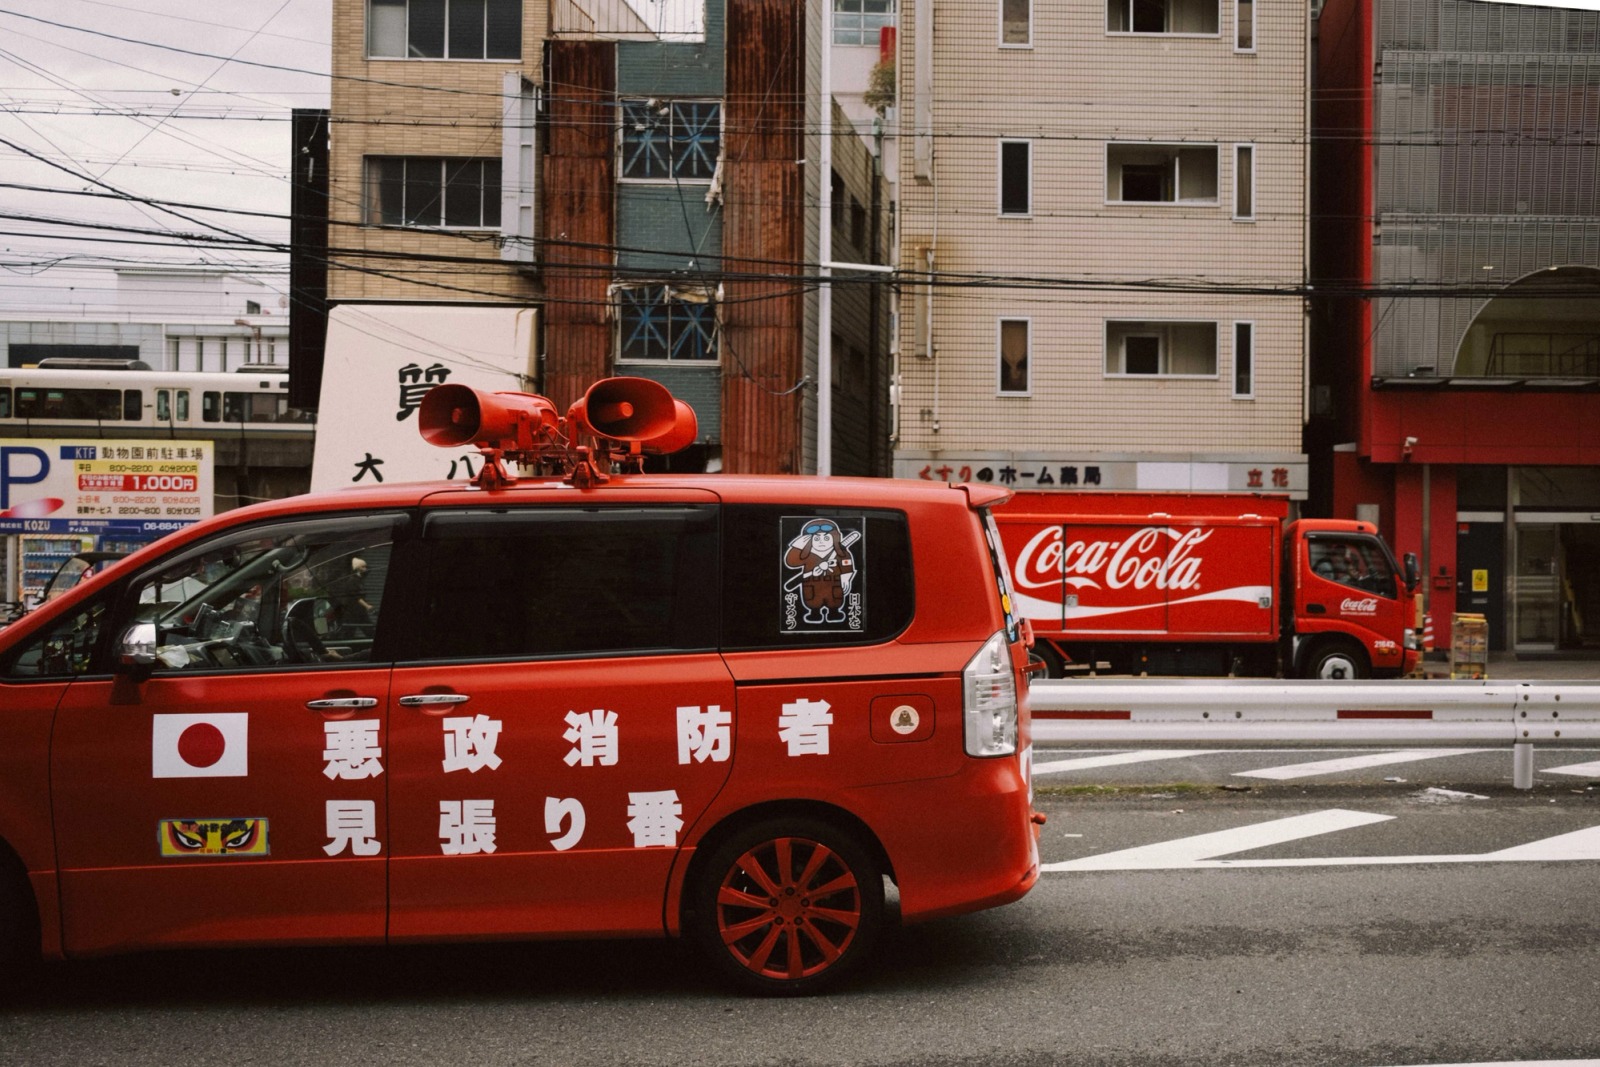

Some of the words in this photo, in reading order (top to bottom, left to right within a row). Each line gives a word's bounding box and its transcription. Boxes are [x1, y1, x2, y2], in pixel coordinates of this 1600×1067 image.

[75, 447, 96, 459] KTF
[102, 446, 204, 460] 動物園前駐車場
[79, 463, 92, 473] 平日
[159, 464, 198, 473] 40分200円
[0, 446, 51, 509] P
[132, 475, 194, 491] 1,000円
[1247, 468, 1289, 487] 立花
[24, 520, 50, 531] KOZU
[1015, 525, 1214, 590] Coca-Cola
[1340, 597, 1378, 611] Coca-Cola
[323, 698, 834, 780] 悪政消防者
[323, 789, 684, 856] 見張り番
